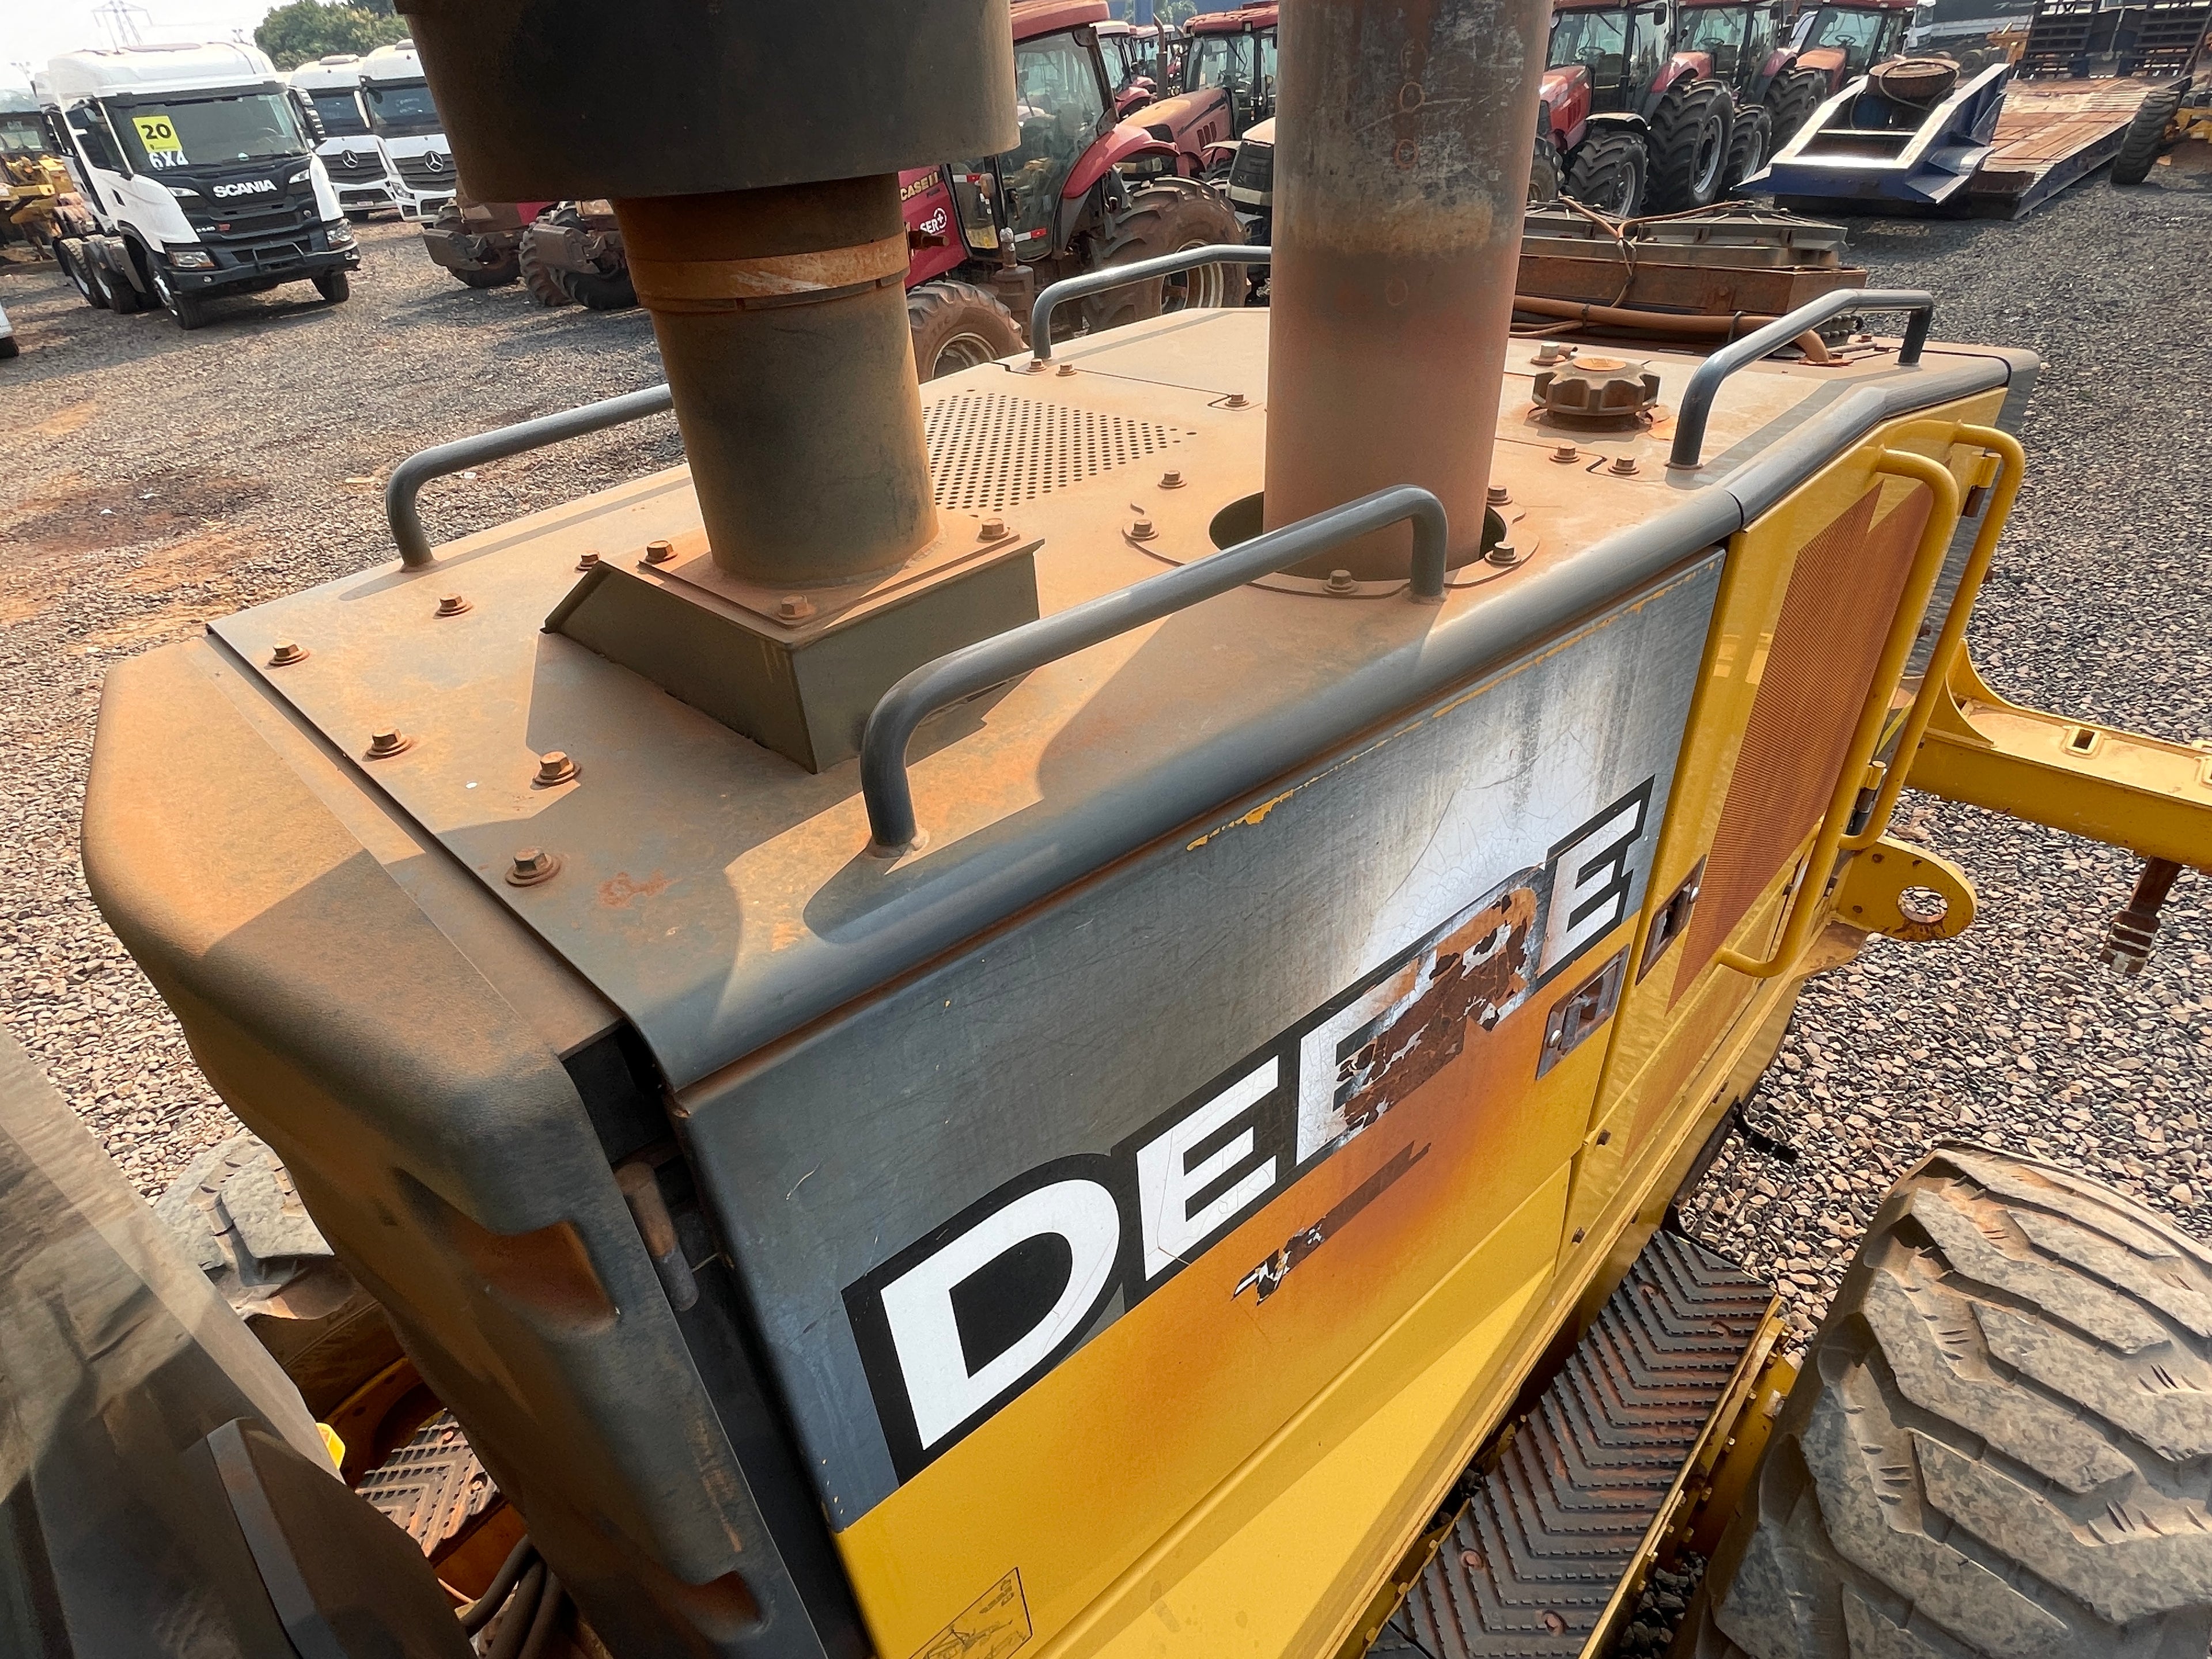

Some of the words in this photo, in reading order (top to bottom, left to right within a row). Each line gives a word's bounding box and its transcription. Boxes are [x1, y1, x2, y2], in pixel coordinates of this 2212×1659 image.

[141, 123, 171, 139] 20
[213, 179, 278, 198] SCANIA
[900, 176, 929, 201] CASE
